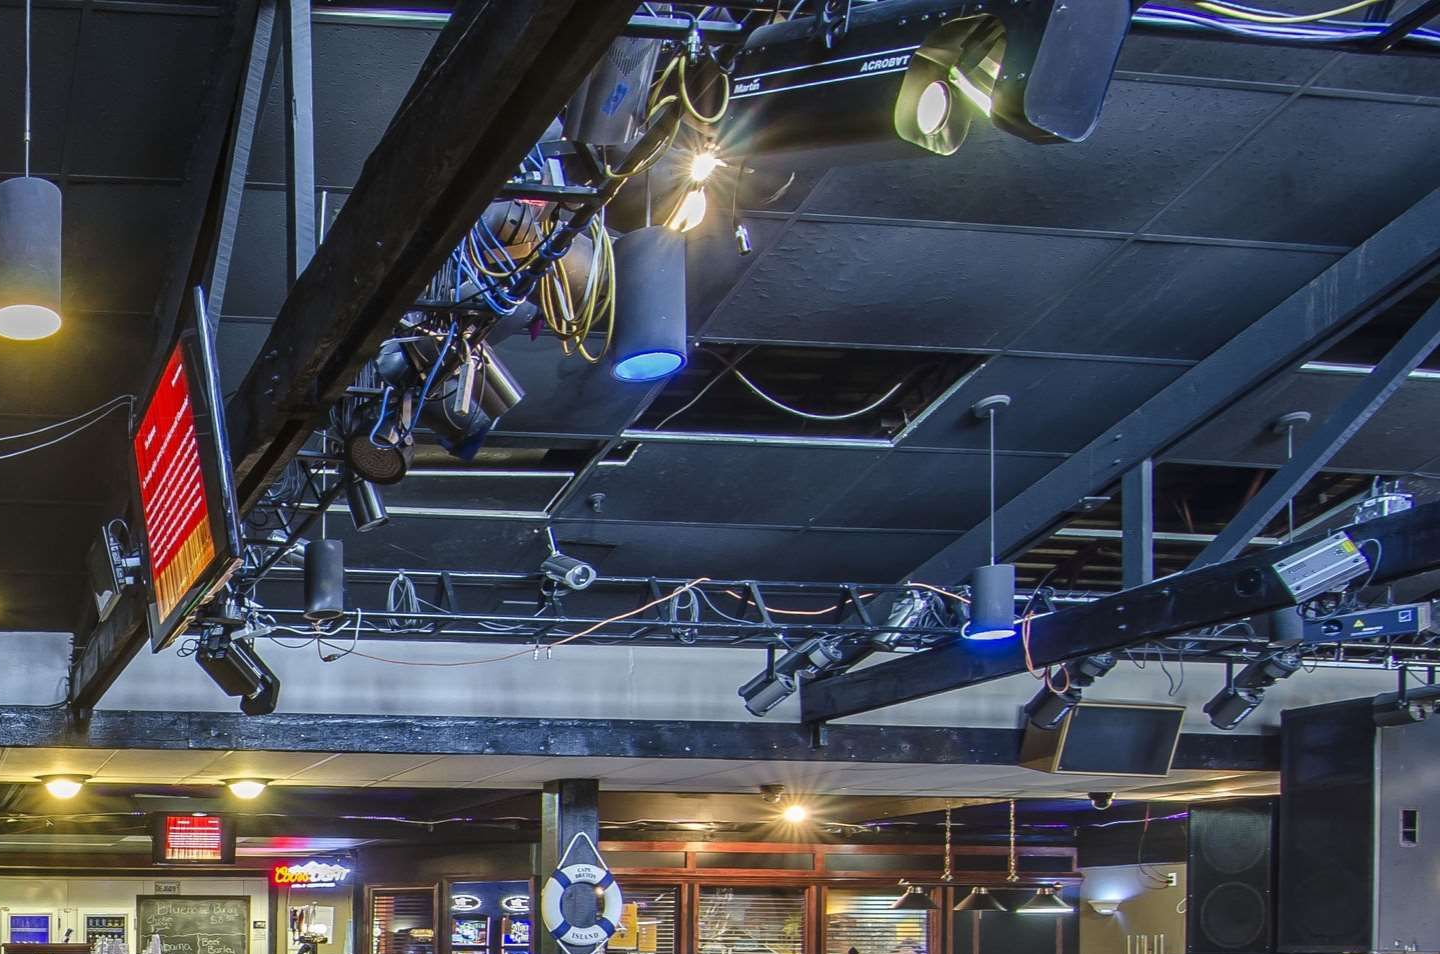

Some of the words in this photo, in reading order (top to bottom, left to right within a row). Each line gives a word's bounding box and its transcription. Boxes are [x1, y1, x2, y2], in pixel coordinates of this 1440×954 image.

[733, 78, 760, 94] Martin
[575, 872, 597, 880] BRETON
[571, 932, 599, 940] ISLAND
[201, 937, 222, 947] Beef
